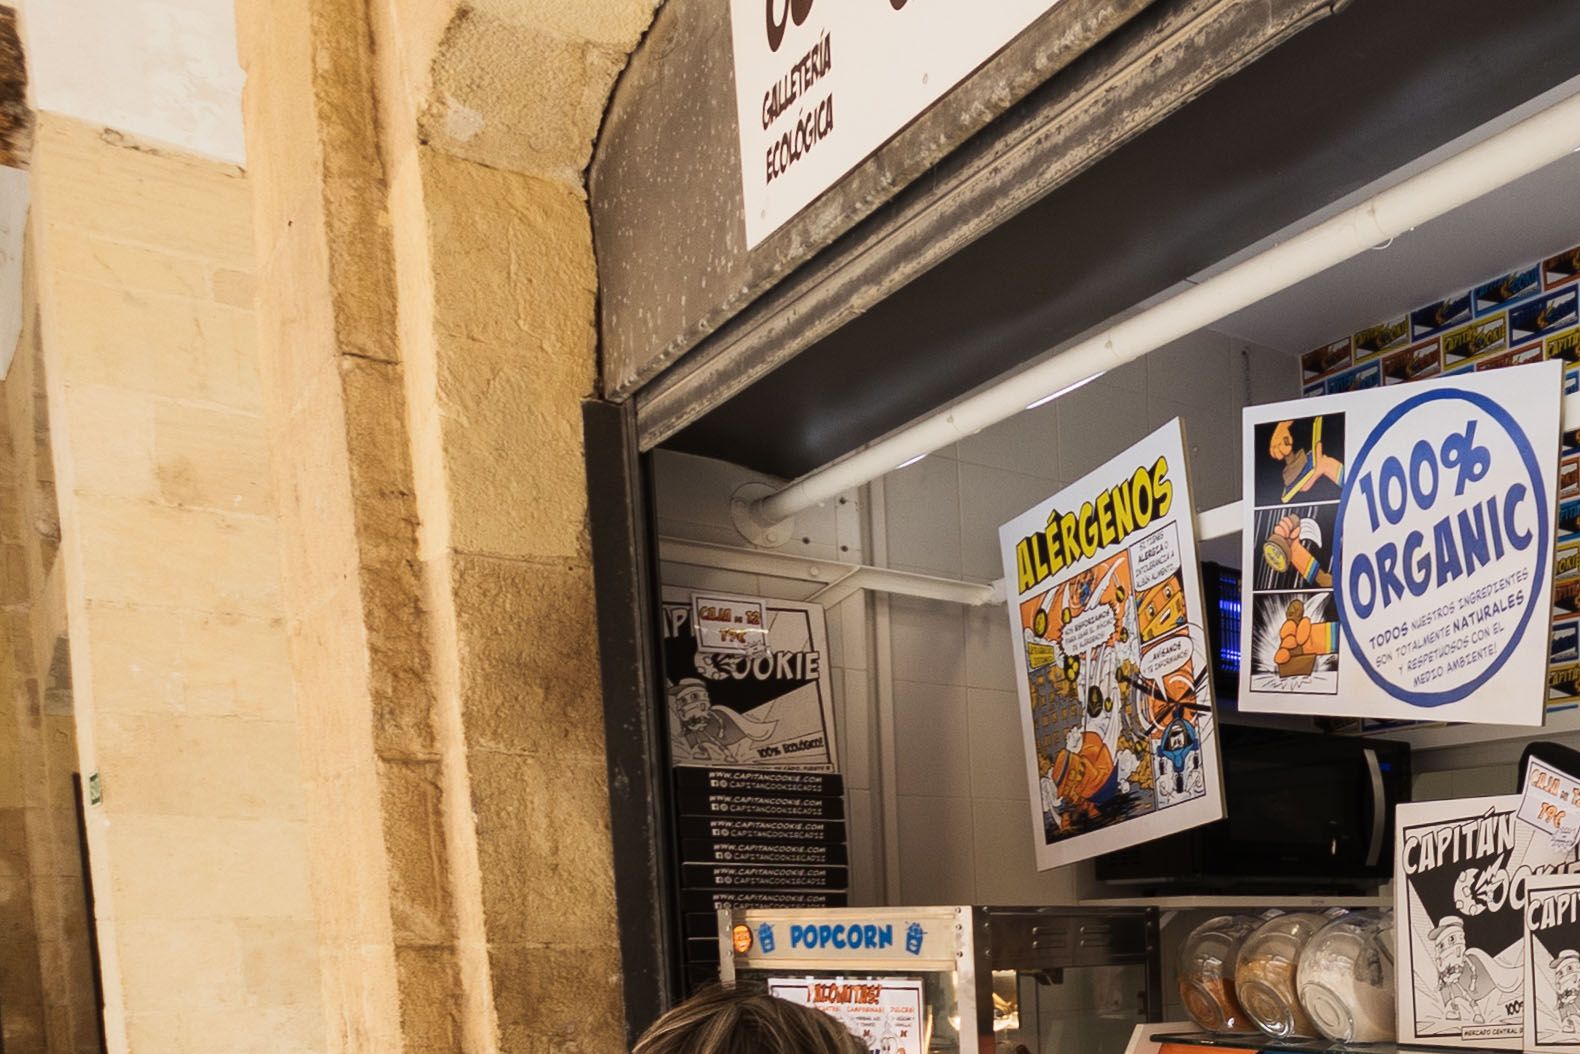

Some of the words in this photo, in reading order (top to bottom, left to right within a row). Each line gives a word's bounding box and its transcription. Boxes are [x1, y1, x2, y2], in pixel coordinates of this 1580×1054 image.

[762, 27, 832, 131] GALLETERÍA
[766, 92, 833, 185] ECOLÓGICA
[1359, 420, 1491, 533] 100%
[1016, 455, 1173, 595] ALÉRGENOS
[1350, 483, 1534, 620] ORGANIC
[1369, 622, 1408, 650] TODOS
[1411, 602, 1456, 631] NUESTROS
[1458, 568, 1529, 610] INGREDIENTES
[1453, 590, 1525, 634] NATURALES
[1413, 666, 1445, 688] MEDIO
[1402, 806, 1516, 875] CAPITÁN
[790, 924, 893, 949] POPCORN
